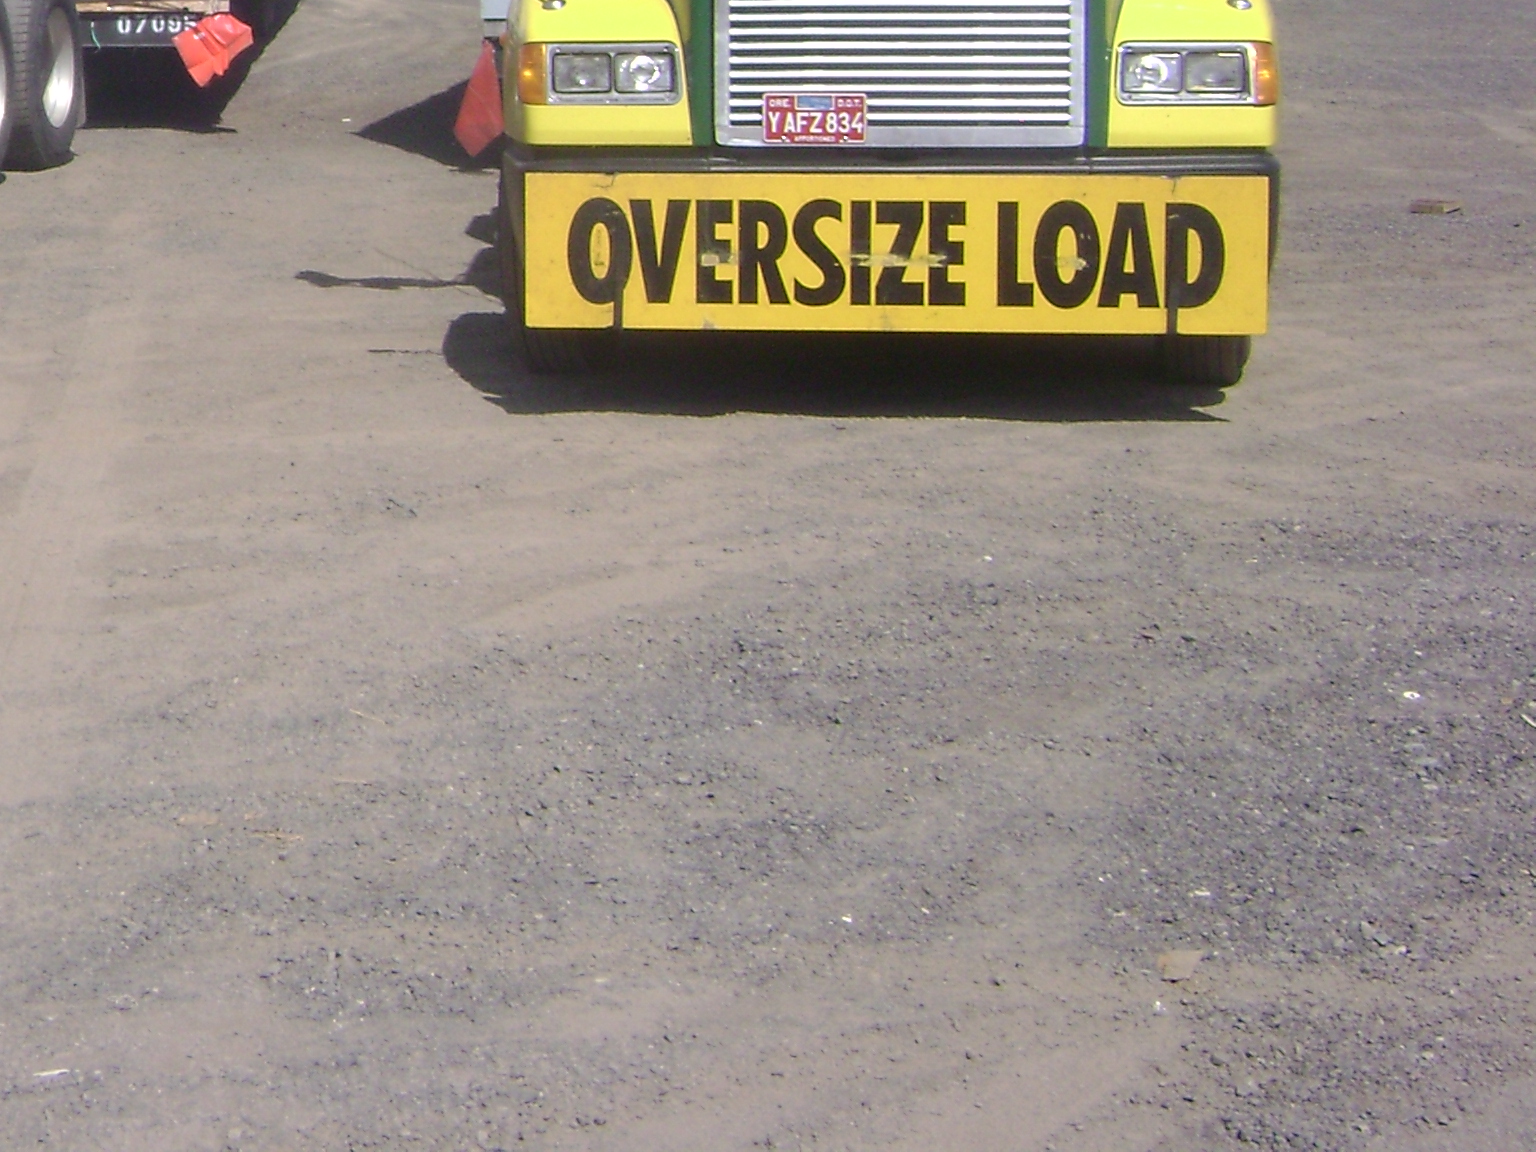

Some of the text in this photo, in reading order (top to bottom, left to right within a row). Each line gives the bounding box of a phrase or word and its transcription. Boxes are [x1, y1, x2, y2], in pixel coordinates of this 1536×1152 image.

[768, 111, 863, 134] YAFZ834
[567, 197, 1226, 309] OVERSIZE LOAD
